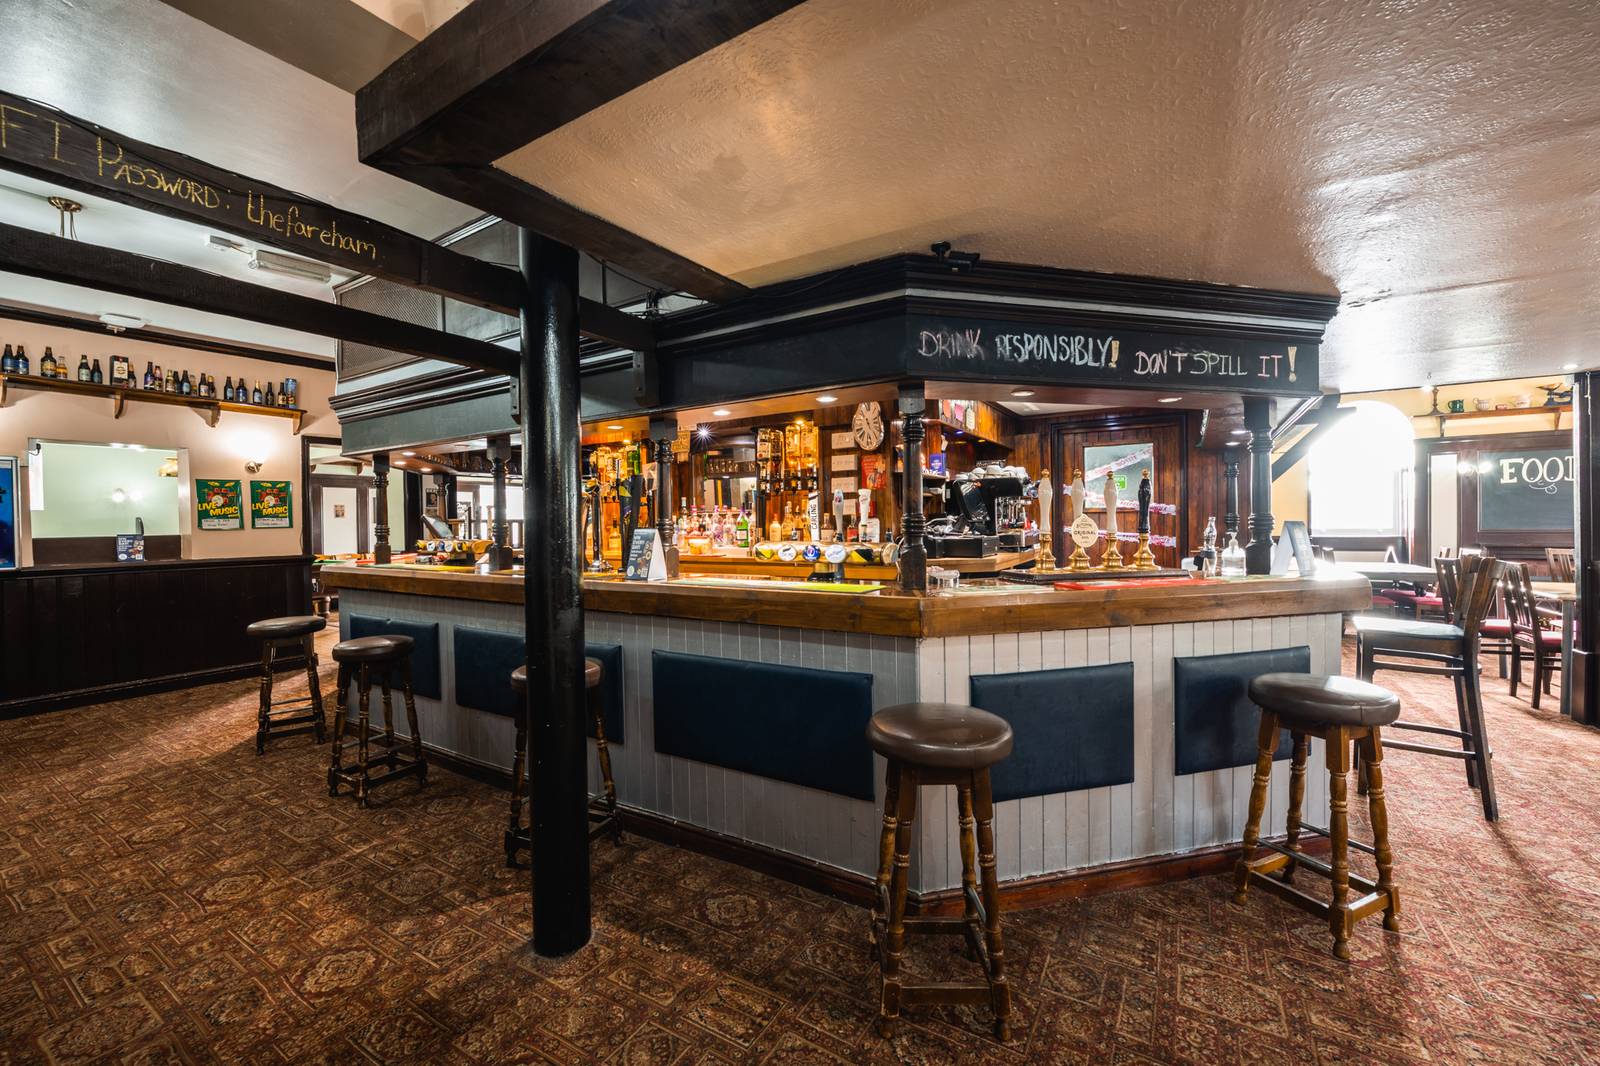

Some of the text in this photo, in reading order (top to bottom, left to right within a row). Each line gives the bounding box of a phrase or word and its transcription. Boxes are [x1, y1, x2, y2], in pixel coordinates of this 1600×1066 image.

[918, 328, 984, 360] DRINK
[995, 332, 1120, 368] RESPONSIBLY!
[1134, 349, 1189, 375] DON'T
[1189, 351, 1247, 376] SPILL
[198, 501, 217, 511] LIVE
[209, 505, 238, 516] MUSIC
[252, 501, 271, 510] LIVE
[262, 505, 288, 516] MUSIC
